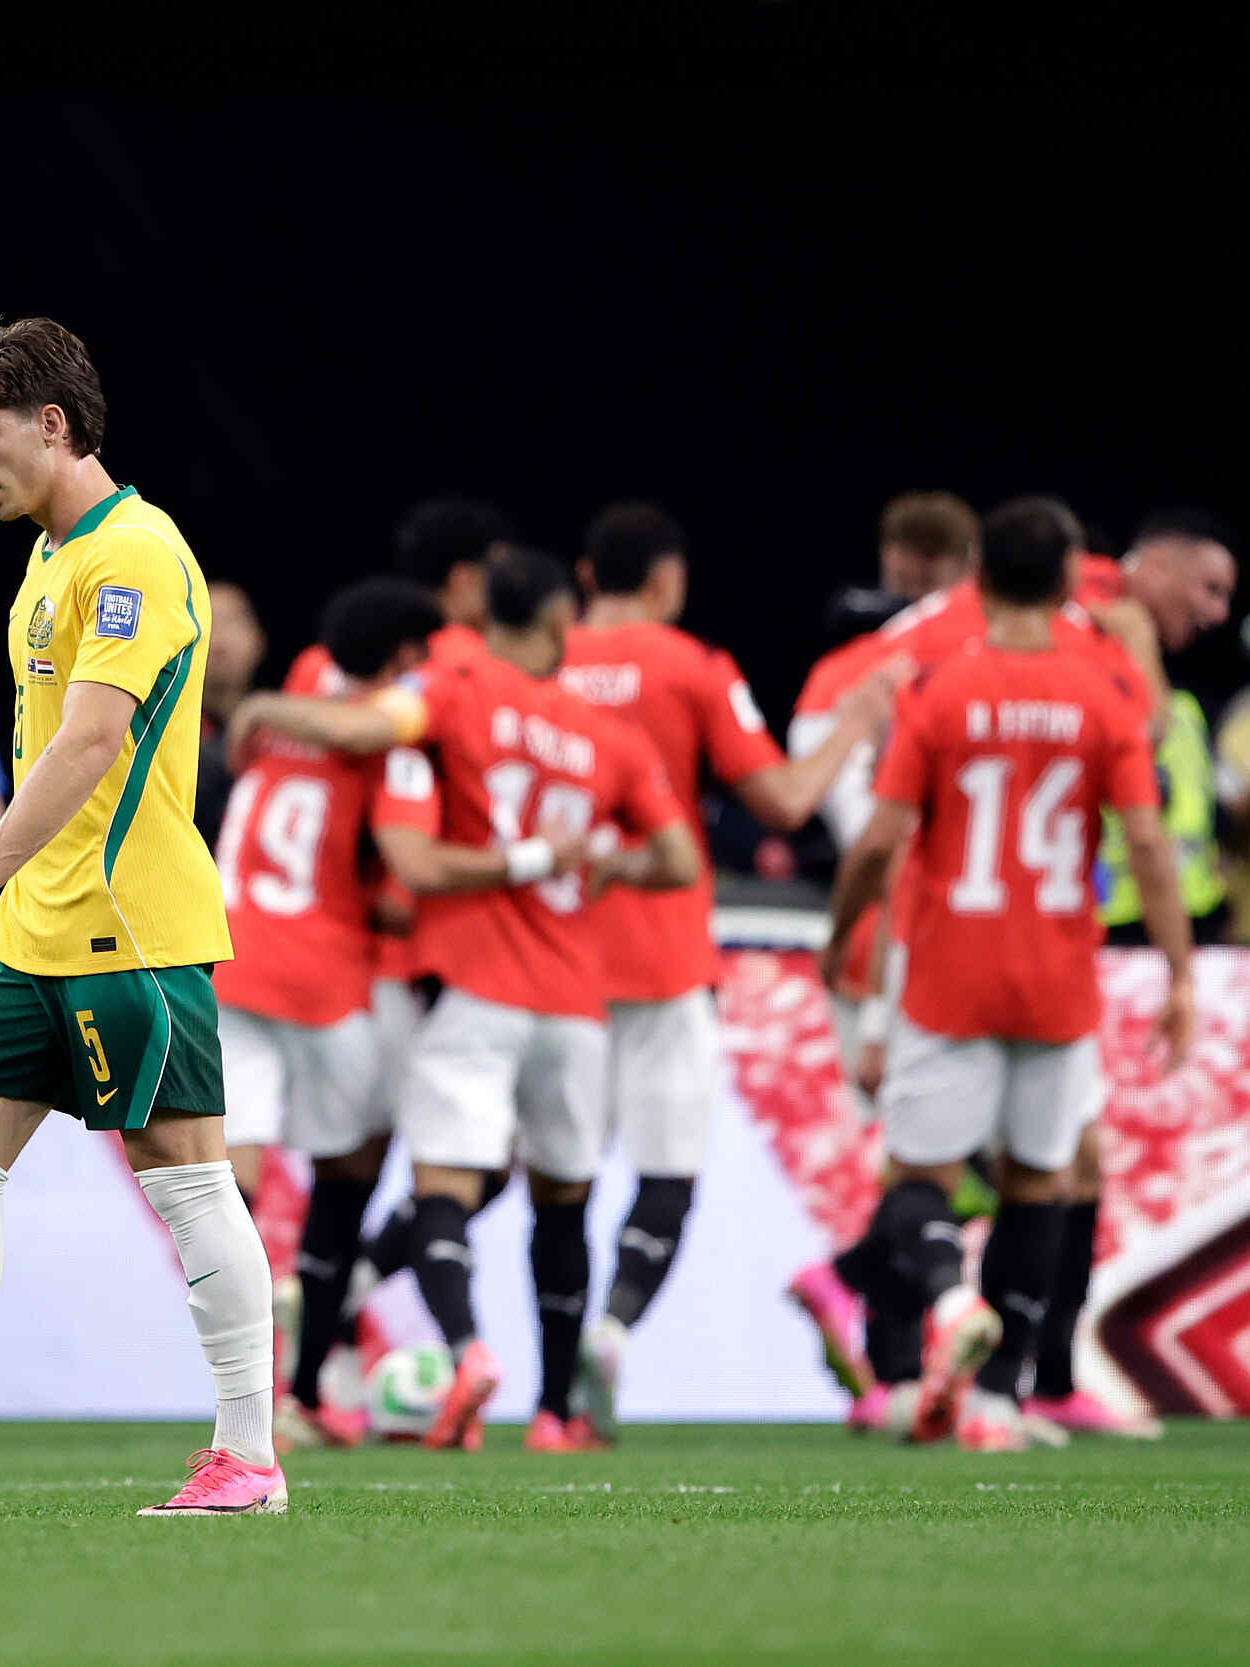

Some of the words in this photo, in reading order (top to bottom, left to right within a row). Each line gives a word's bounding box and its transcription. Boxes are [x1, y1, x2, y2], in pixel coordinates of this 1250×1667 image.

[104, 602, 133, 616] UNITES
[216, 768, 332, 916] 19
[948, 754, 1089, 916] 14
[75, 1009, 111, 1082] 5
